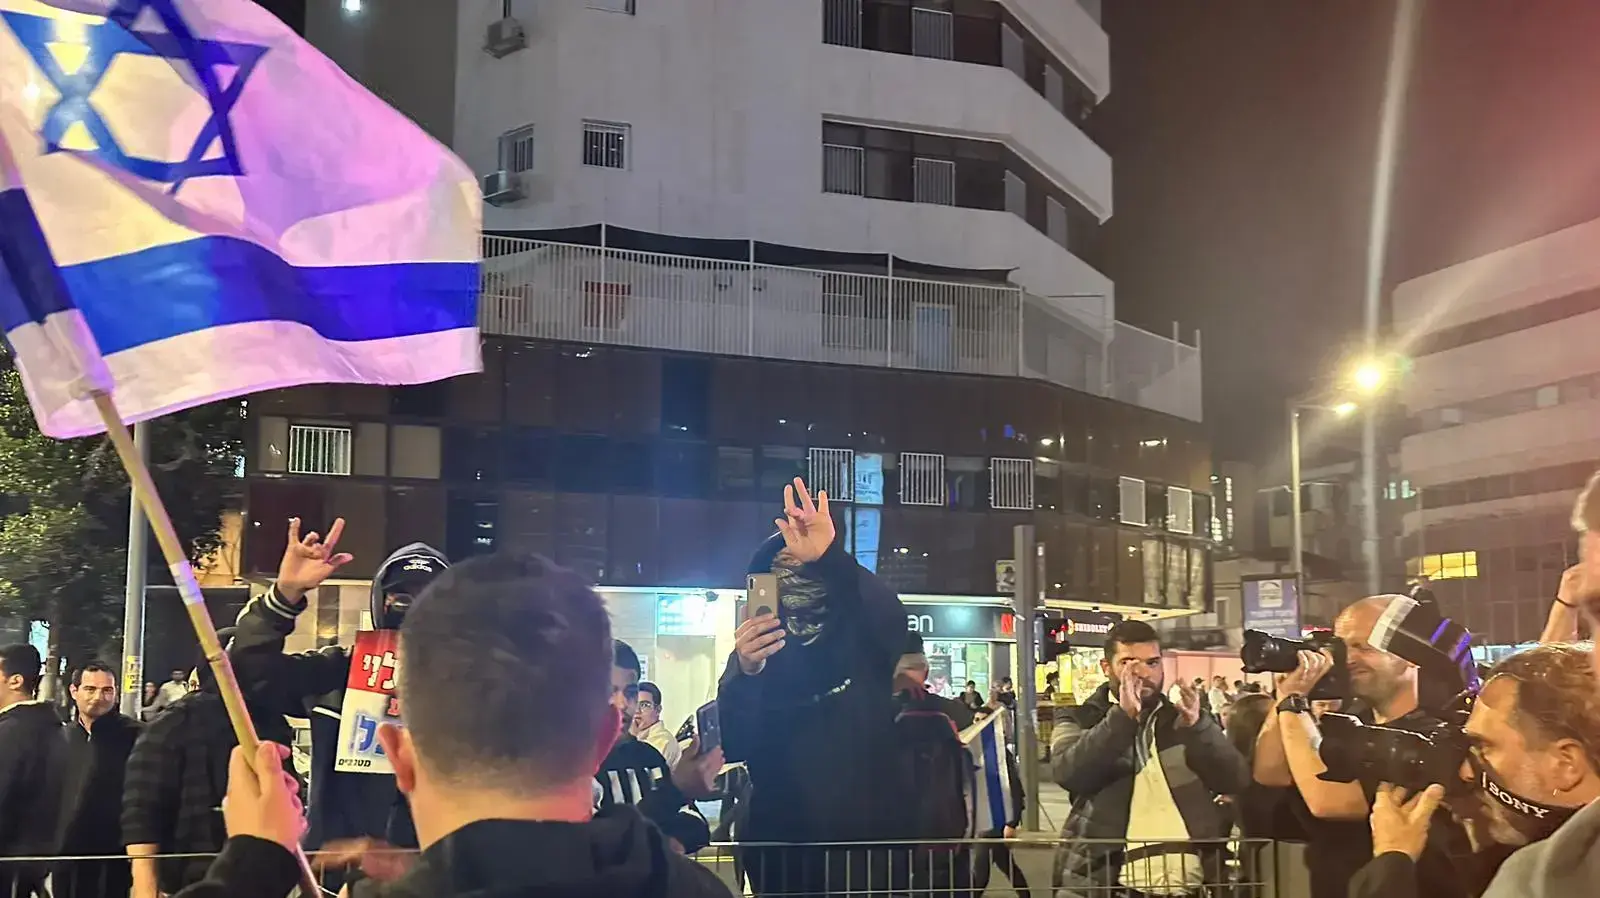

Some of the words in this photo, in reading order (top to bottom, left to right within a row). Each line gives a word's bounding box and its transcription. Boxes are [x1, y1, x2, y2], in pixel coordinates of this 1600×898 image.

[403, 563, 432, 572] adidas
[907, 614, 933, 632] an
[1489, 781, 1550, 819] SONY
